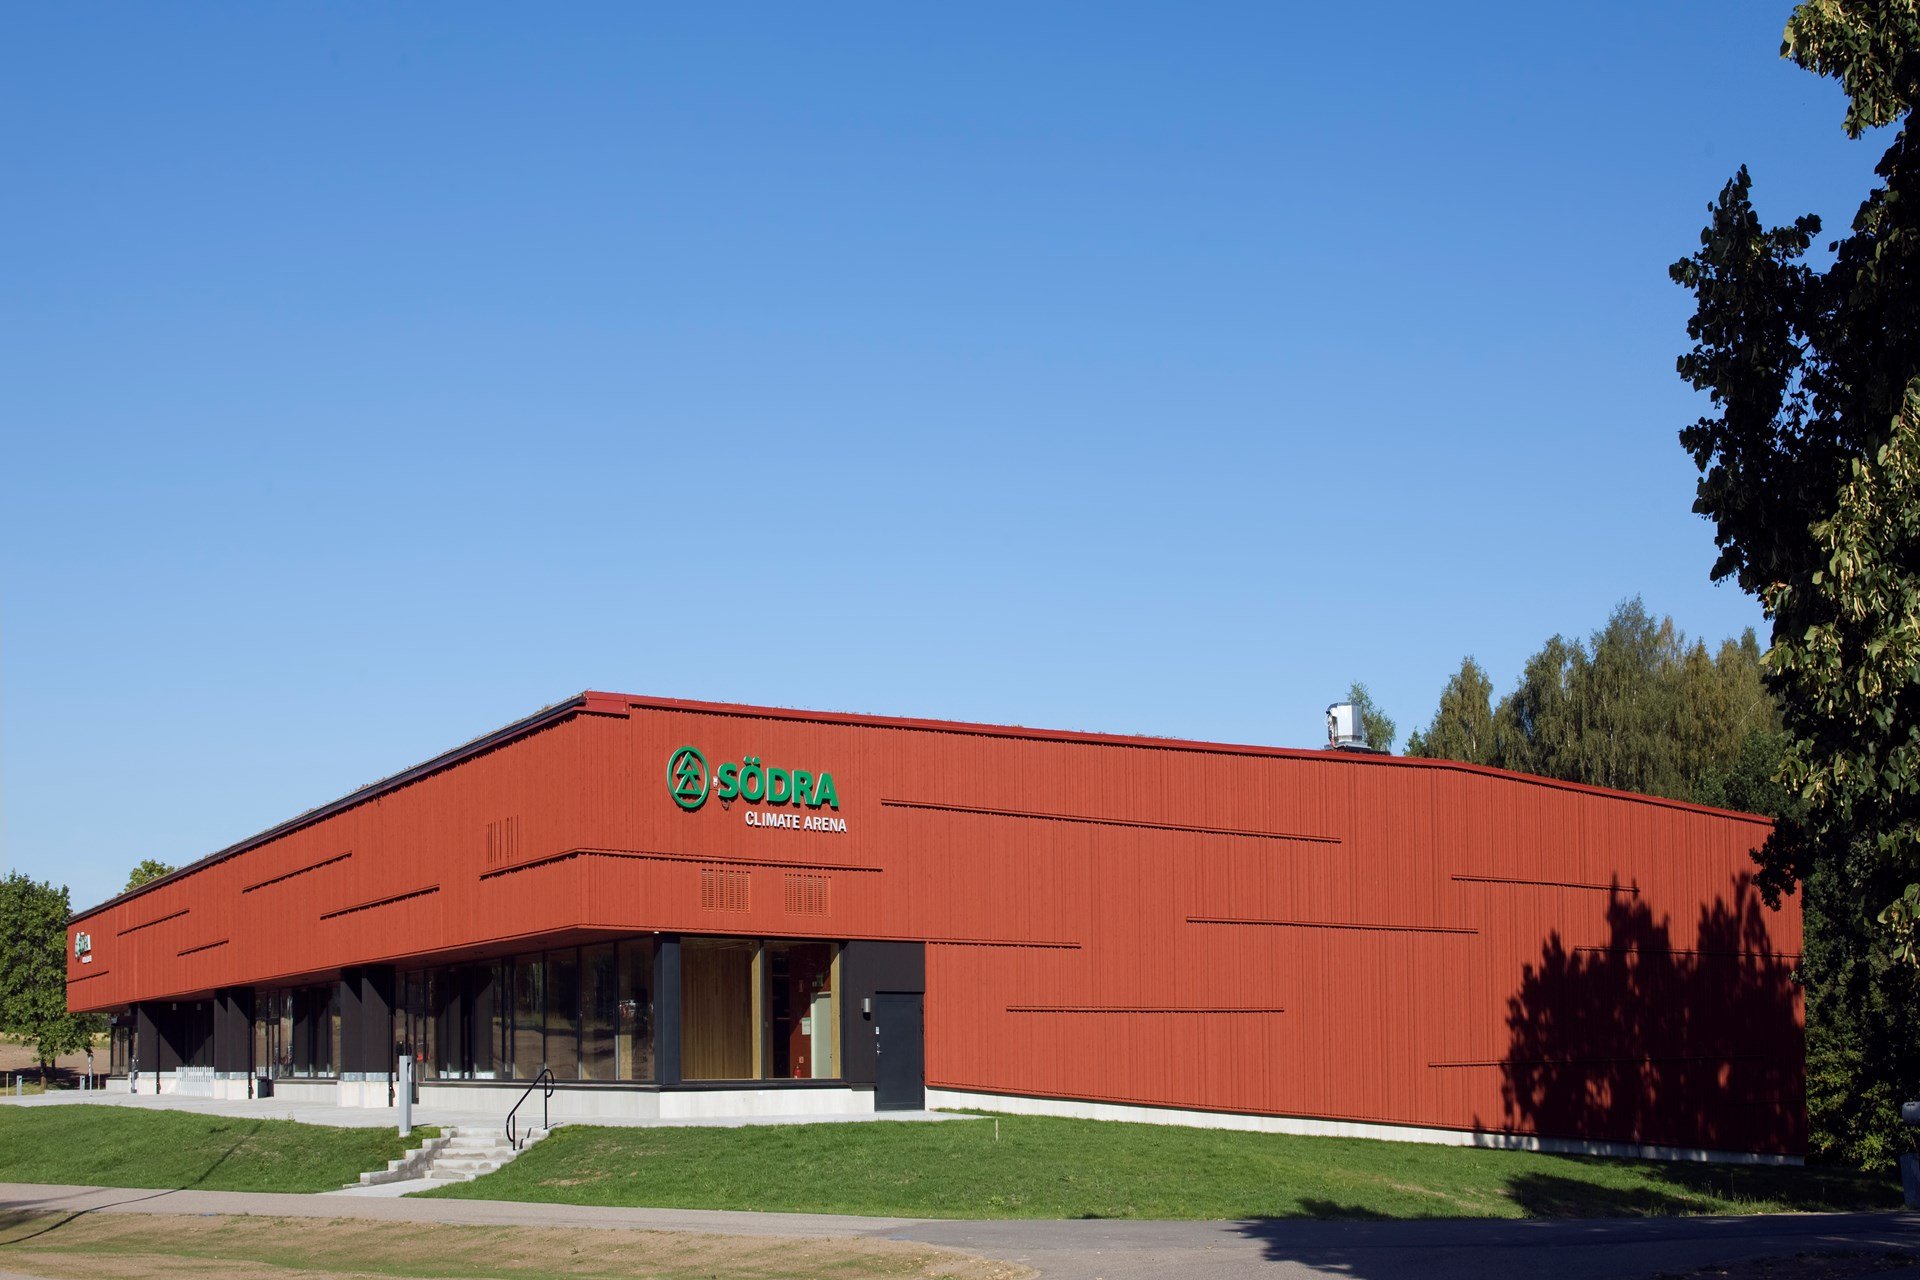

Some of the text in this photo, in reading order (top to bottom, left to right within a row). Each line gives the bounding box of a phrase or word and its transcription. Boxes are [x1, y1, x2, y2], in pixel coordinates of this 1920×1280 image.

[717, 756, 839, 807] SÖDRA
[745, 811, 847, 833] CLIMATE ARENA
